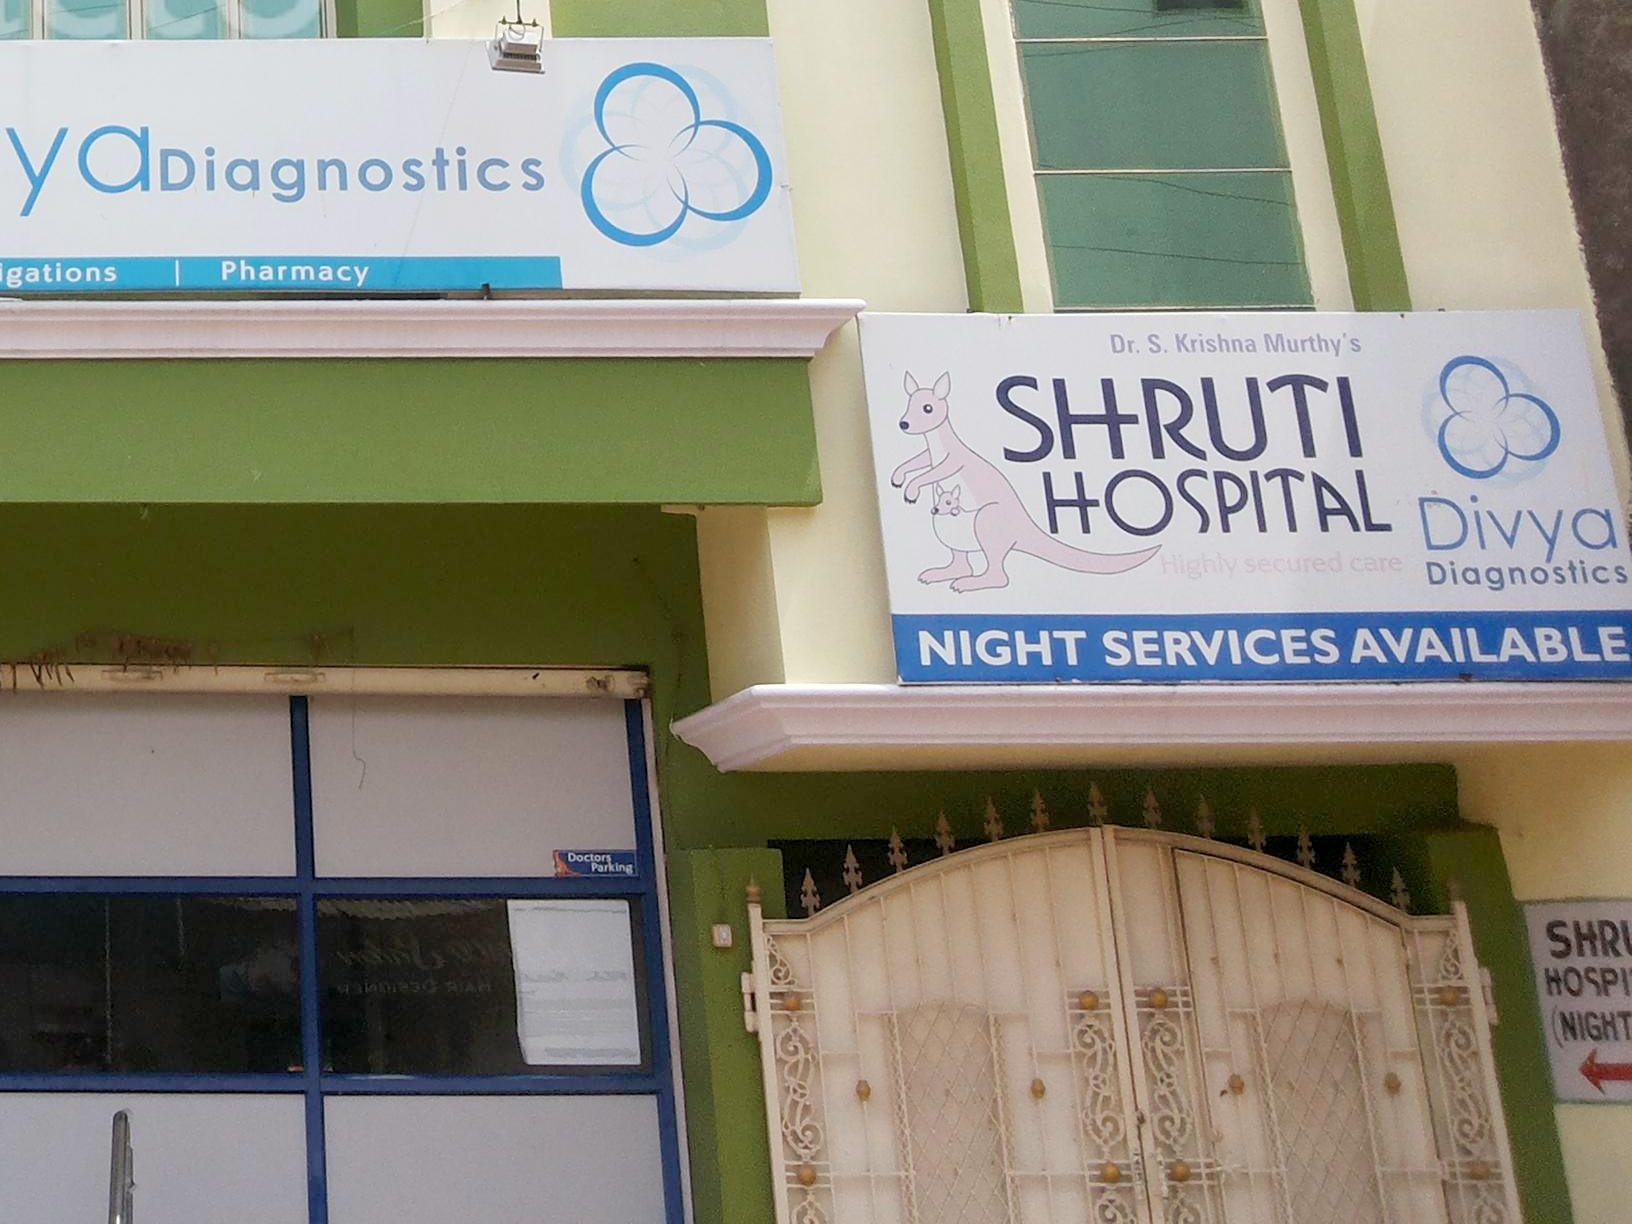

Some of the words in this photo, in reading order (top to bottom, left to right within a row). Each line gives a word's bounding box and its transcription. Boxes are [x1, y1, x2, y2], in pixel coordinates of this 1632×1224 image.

[159, 146, 546, 203] Diagnostics
[221, 260, 370, 287] Pharmacy
[1110, 333, 1141, 355] Dr.
[1148, 333, 1169, 354] S.
[1175, 332, 1257, 354] Krishna
[1265, 332, 1362, 357] Murthy's
[995, 374, 1364, 463] SHRUTI
[1041, 468, 1393, 537] HOSPITAL
[1417, 494, 1618, 564] Divya
[1160, 552, 1238, 579] Highly
[1244, 551, 1343, 574] secured
[1350, 556, 1404, 574] care
[1425, 559, 1629, 592] Diagnostics
[917, 629, 1088, 667] NIGHT
[1103, 628, 1341, 667] SERVICES
[1350, 626, 1632, 665] AVAILABLE
[567, 852, 612, 863] Doctors
[591, 862, 634, 875] Parking
[1544, 965, 1632, 997] HOSPI
